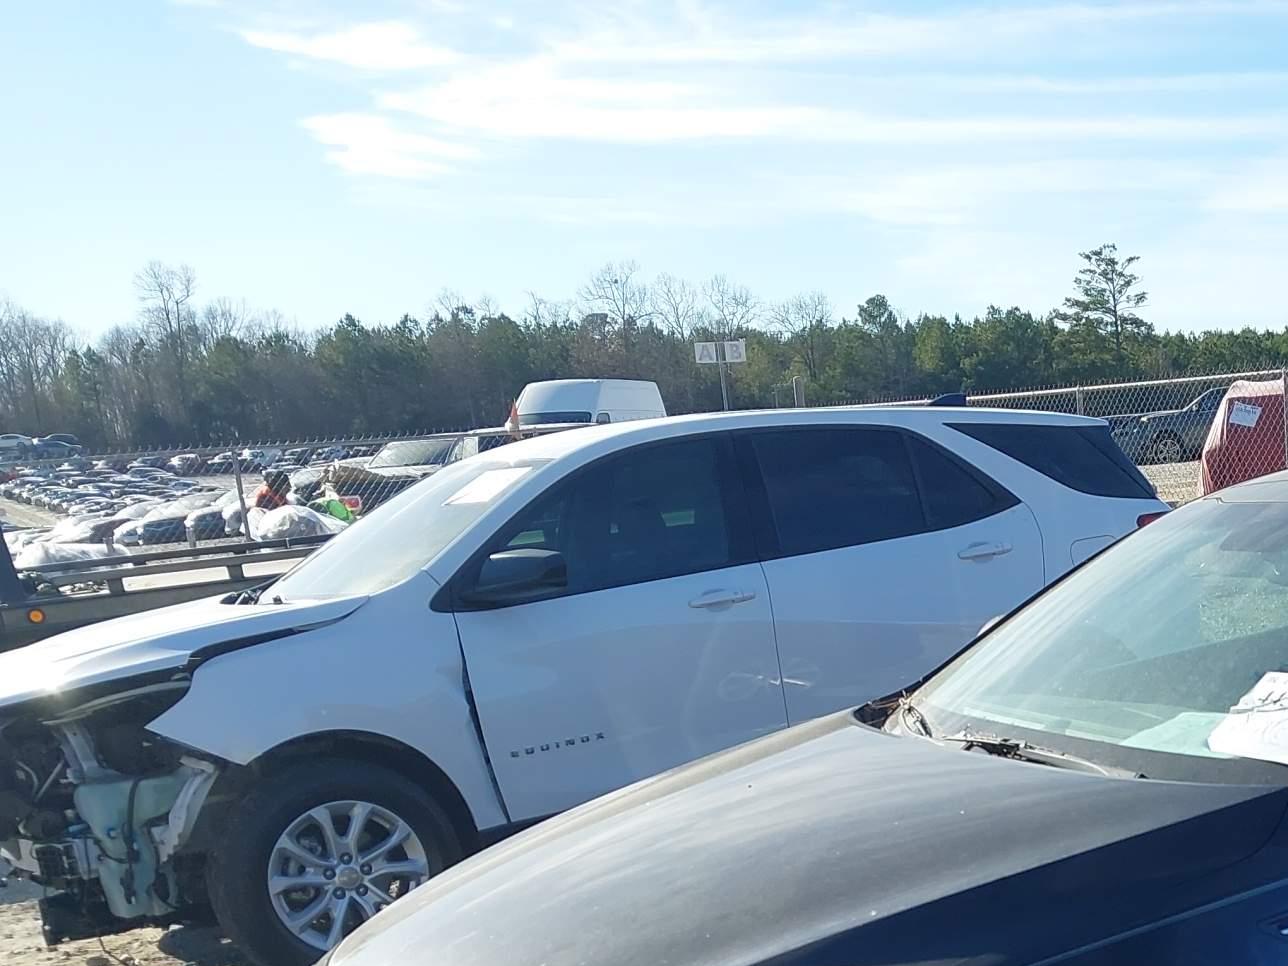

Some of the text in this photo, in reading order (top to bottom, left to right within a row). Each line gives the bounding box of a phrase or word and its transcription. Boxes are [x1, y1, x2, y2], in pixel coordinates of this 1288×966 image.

[698, 344, 742, 361] A B
[510, 732, 605, 758] EQUINOX
